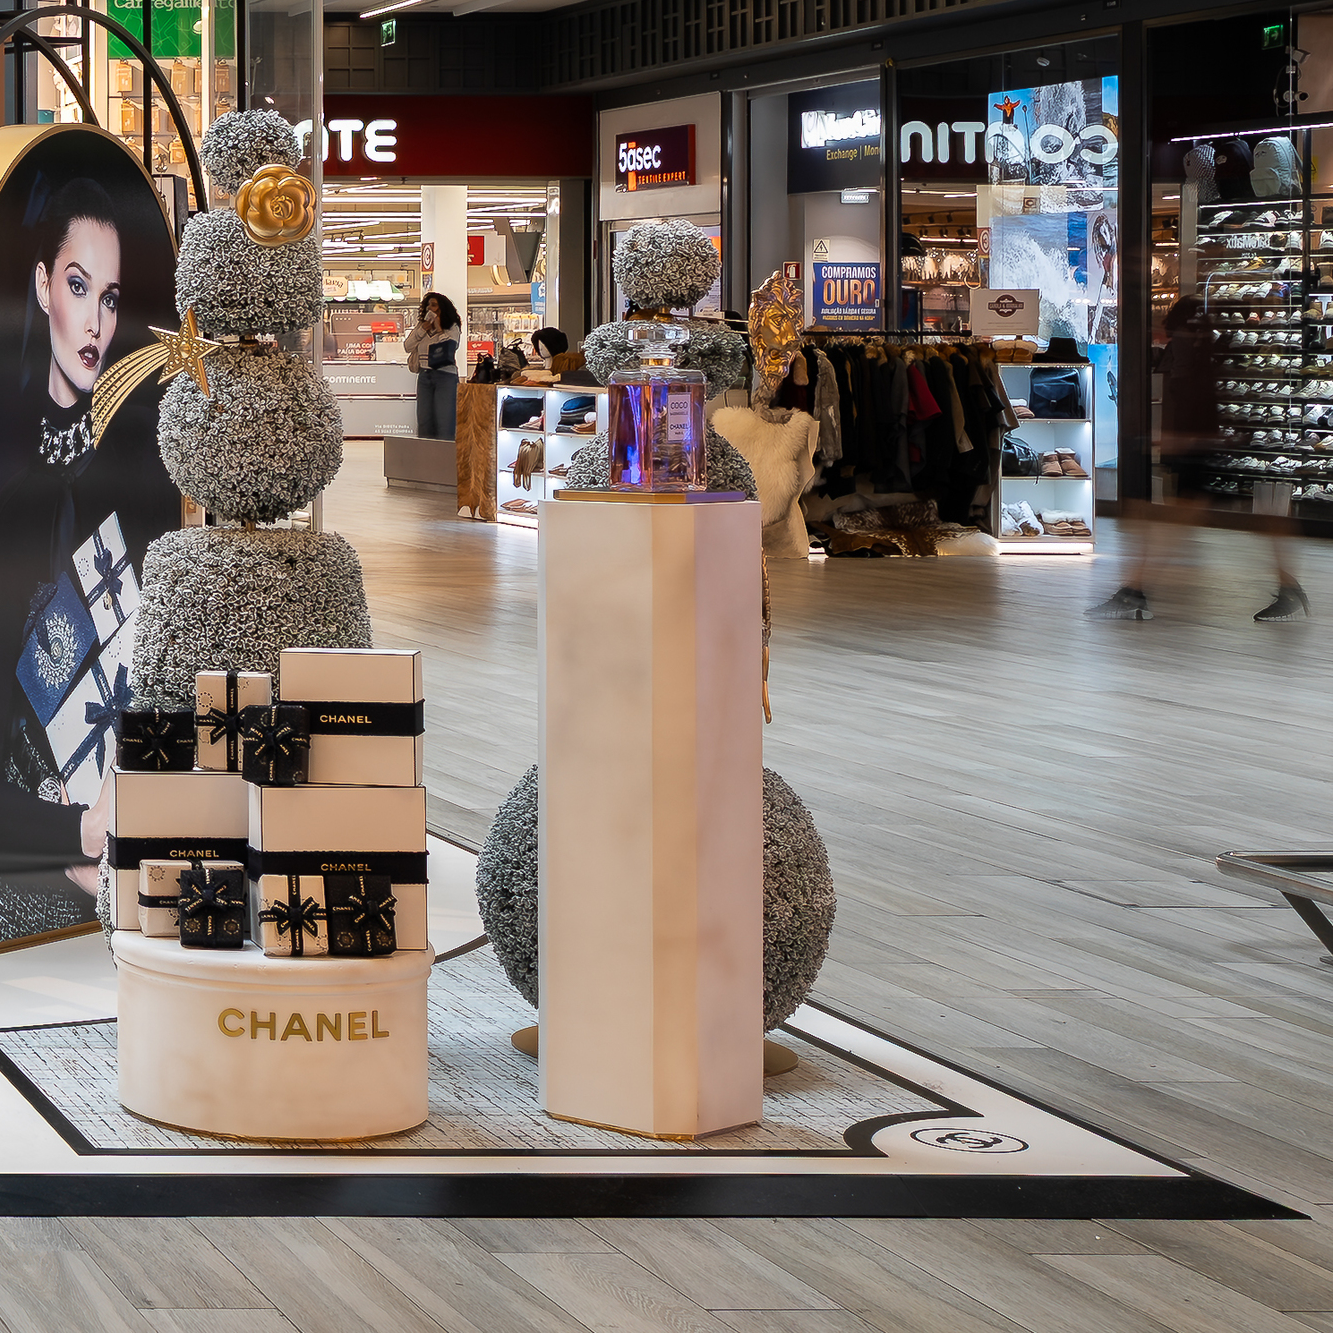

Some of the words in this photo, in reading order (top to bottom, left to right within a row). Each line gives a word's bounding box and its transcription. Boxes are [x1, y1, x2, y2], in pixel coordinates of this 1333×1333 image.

[618, 142, 661, 172] 5asec
[826, 147, 858, 161] Exchange
[822, 266, 876, 278] COMPRAMOS
[823, 279, 875, 305] OURO
[670, 401, 688, 410] COCO
[320, 714, 372, 724] CHANEL
[169, 850, 220, 858] CHANEL
[321, 863, 372, 871] CHANEL
[217, 1007, 390, 1042] CHANEL
